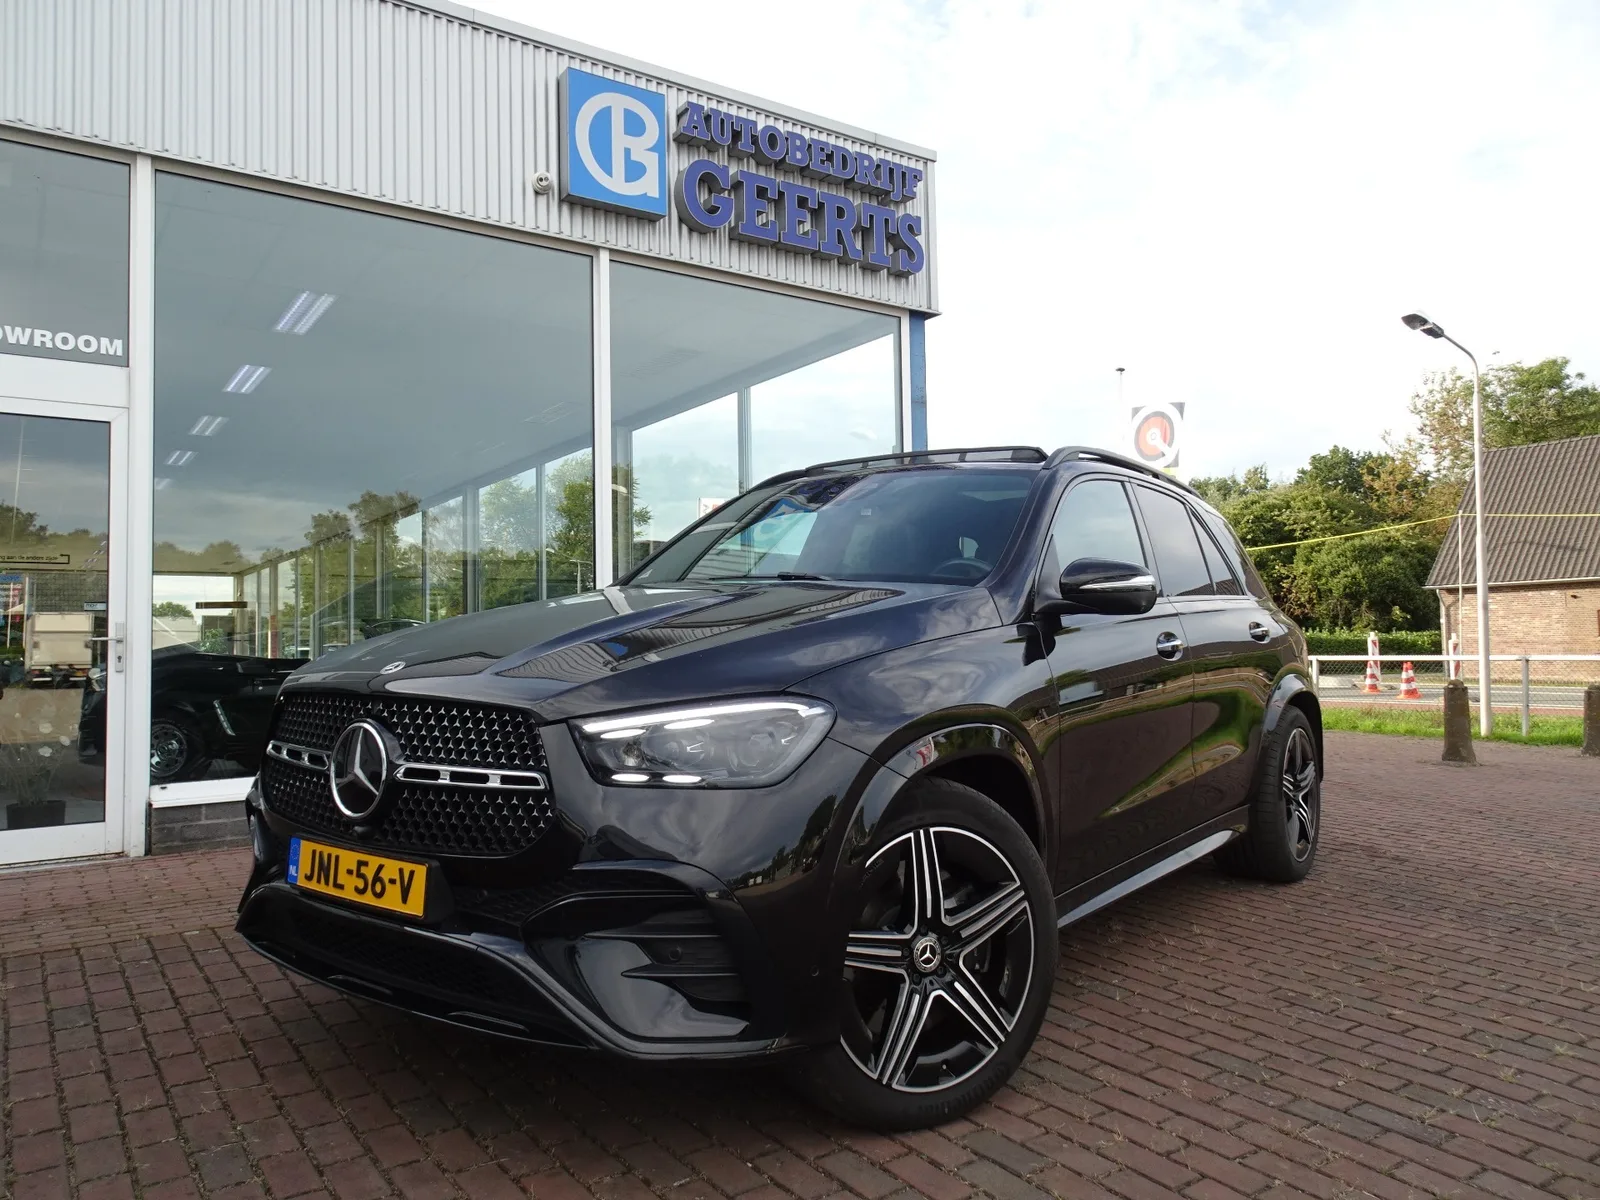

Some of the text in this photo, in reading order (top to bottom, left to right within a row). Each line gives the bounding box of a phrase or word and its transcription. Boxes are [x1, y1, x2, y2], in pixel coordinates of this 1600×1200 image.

[680, 101, 923, 202] AUTOBEDRIJF
[680, 159, 924, 275] GEERTS
[0, 325, 123, 357] WROOM
[288, 864, 298, 877] NL
[304, 849, 415, 905] JNL-56-V
